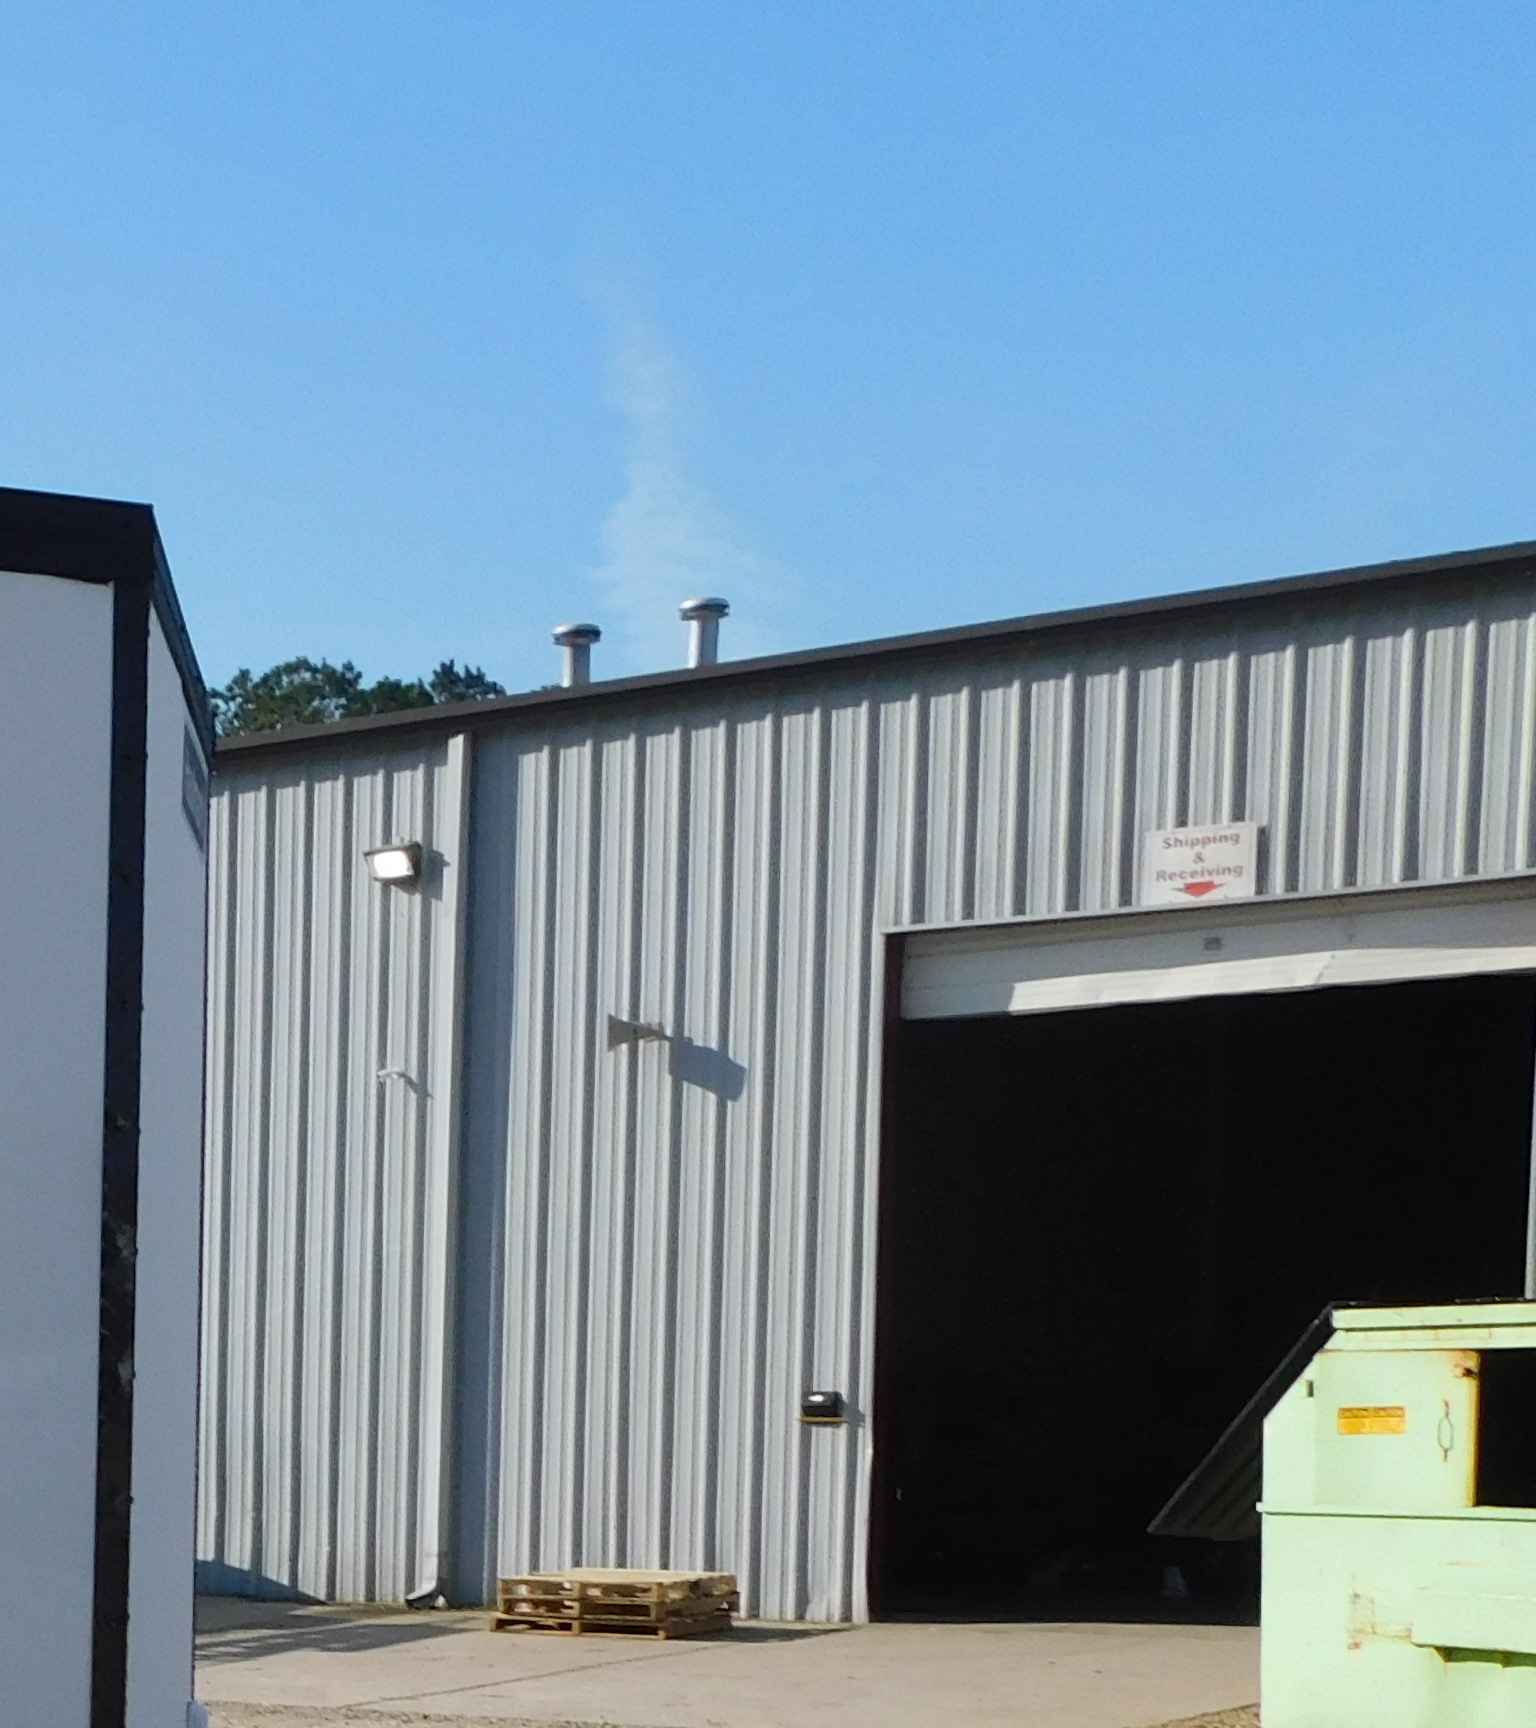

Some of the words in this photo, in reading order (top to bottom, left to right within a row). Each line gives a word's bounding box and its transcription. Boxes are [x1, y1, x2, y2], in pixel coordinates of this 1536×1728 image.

[1162, 832, 1241, 849] Shipping
[1192, 851, 1206, 864] &
[1155, 864, 1244, 882] Receiving
